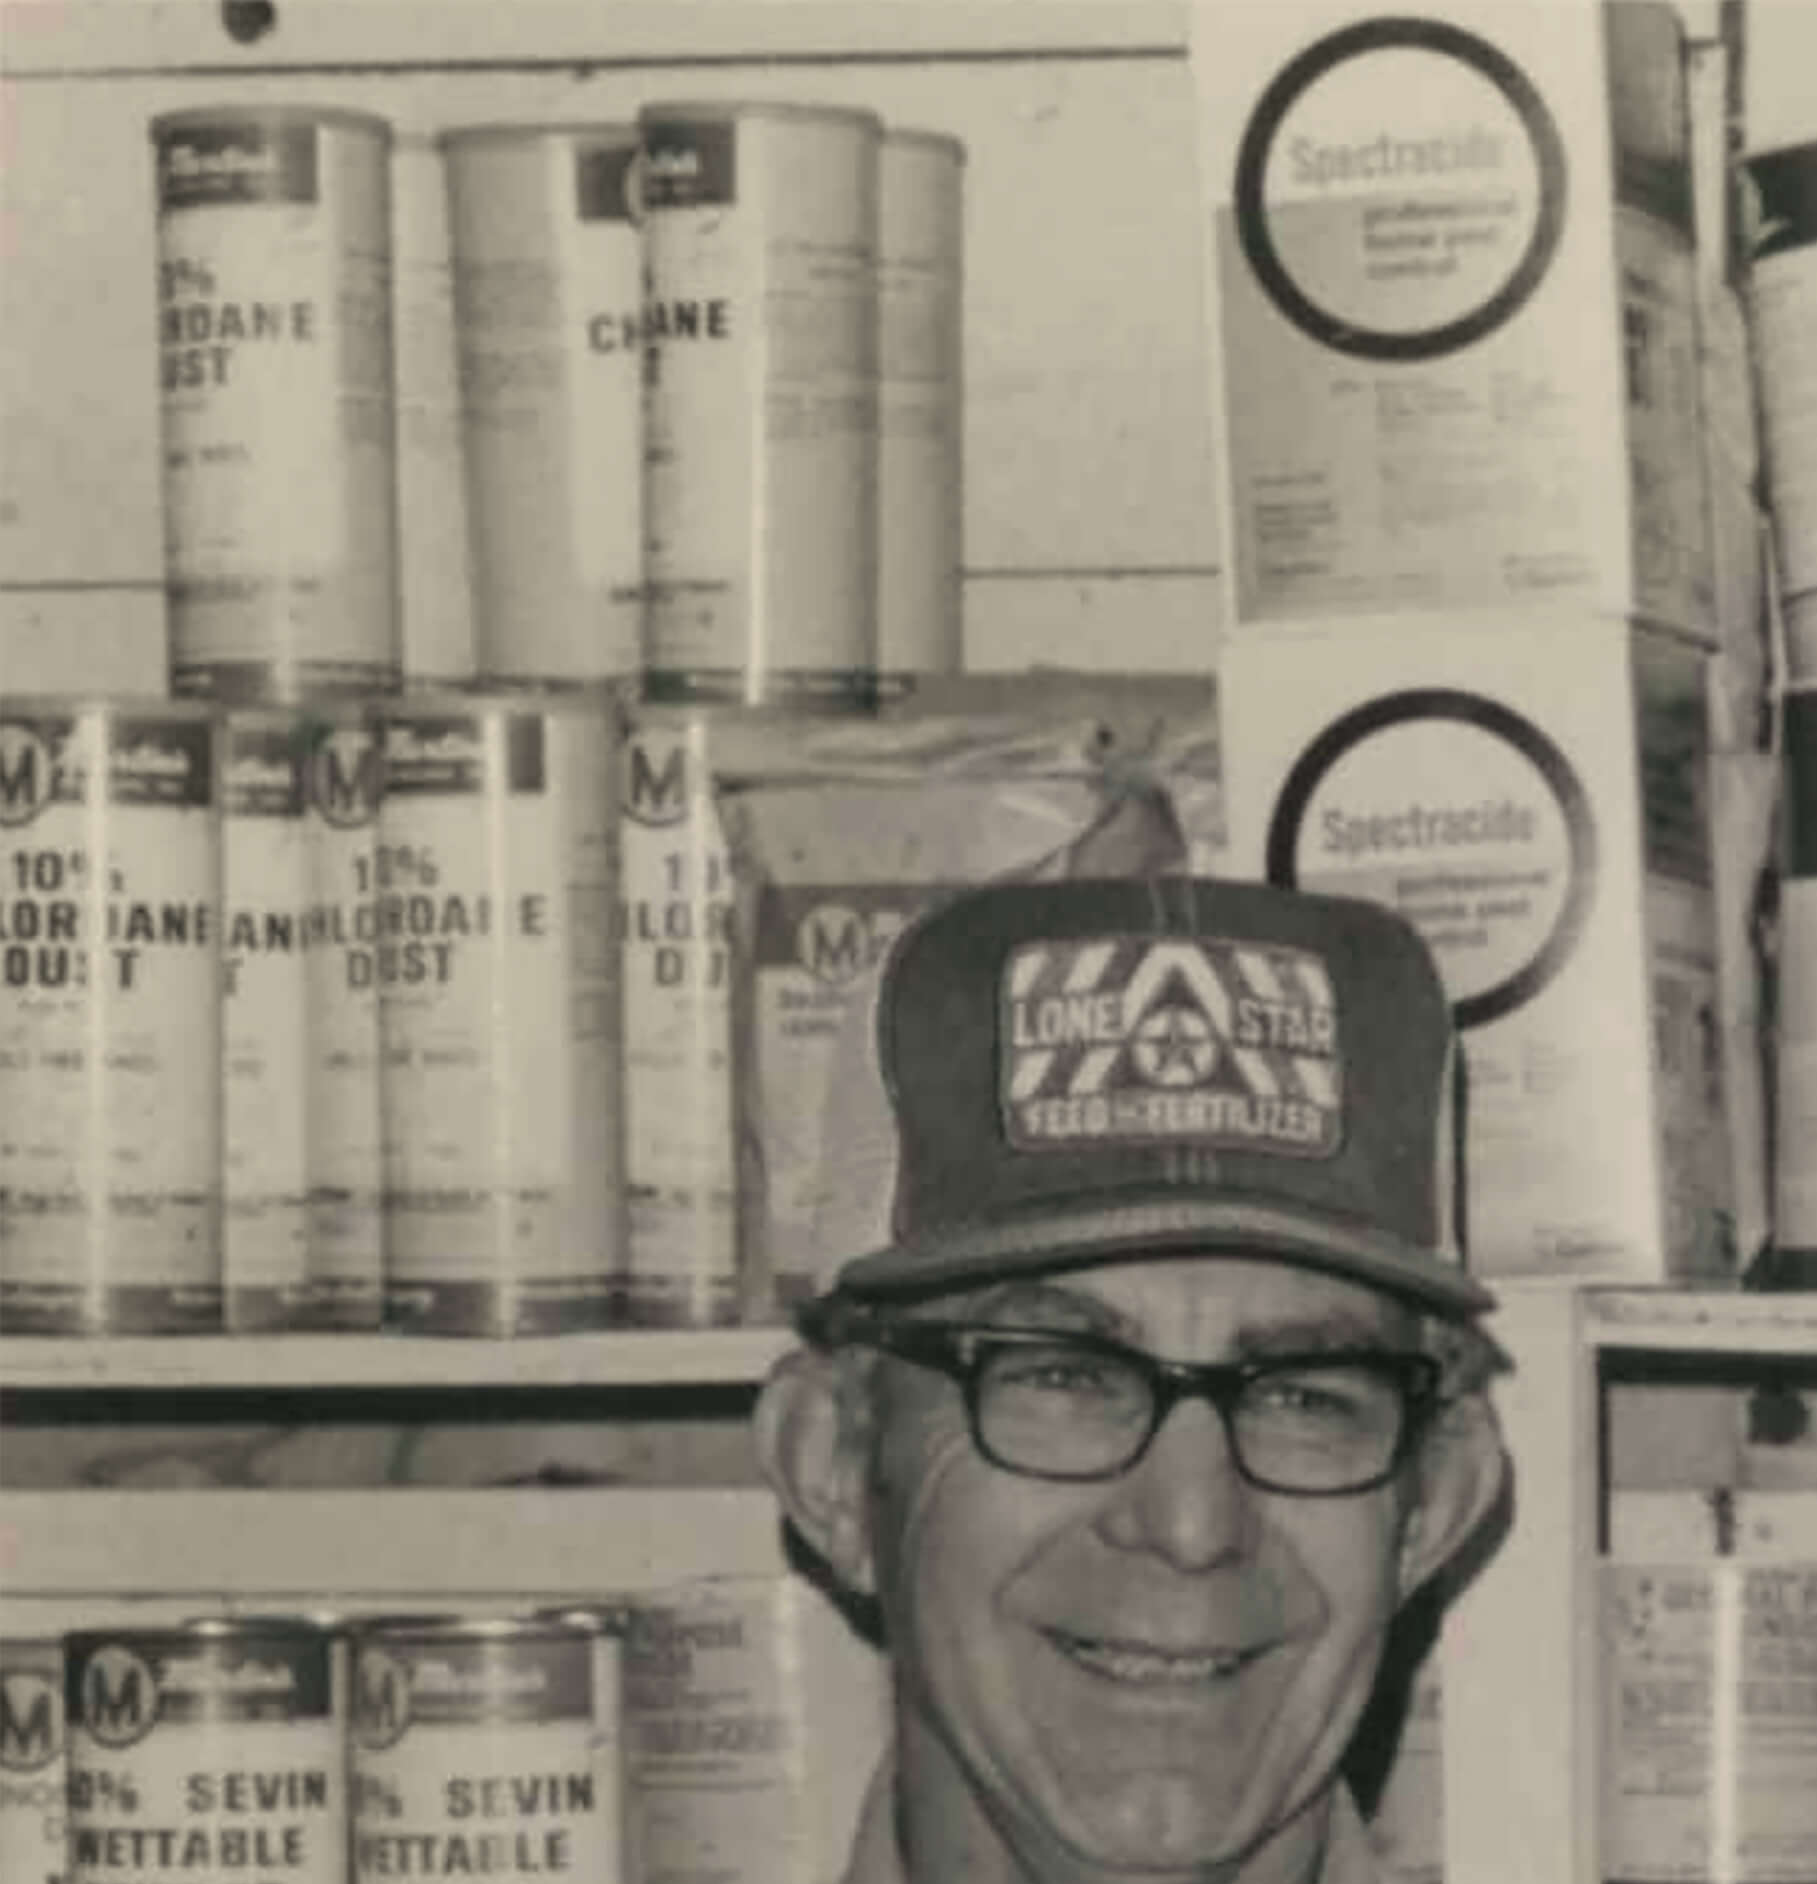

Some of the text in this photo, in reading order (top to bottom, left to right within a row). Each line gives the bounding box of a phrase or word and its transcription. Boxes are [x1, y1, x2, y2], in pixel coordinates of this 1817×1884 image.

[1288, 125, 1505, 190] Spectracide
[1320, 803, 1536, 858] Spectracide
[1013, 996, 1333, 1052] LONE STAR
[187, 1771, 328, 1813] SEVIN
[445, 1771, 595, 1818] SEVIN
